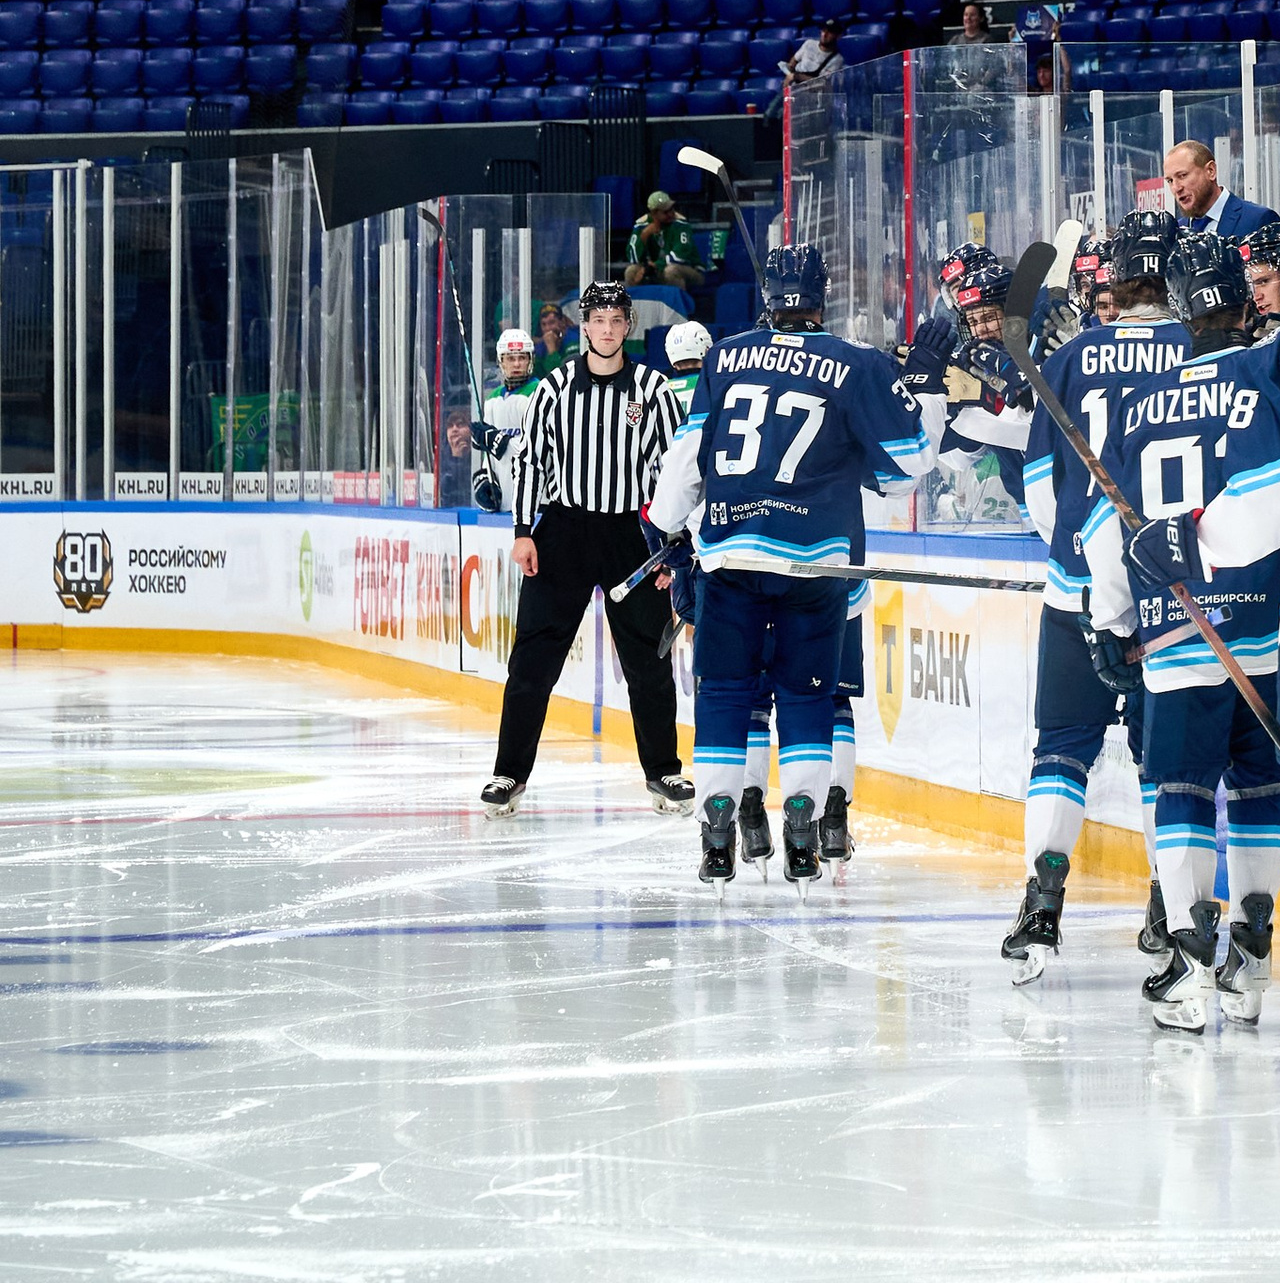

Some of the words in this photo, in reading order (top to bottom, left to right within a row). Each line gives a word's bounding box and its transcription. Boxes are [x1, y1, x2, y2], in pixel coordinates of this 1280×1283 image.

[1143, 256, 1159, 273] 14
[784, 293, 800, 308] 37
[1203, 286, 1223, 308] 91
[716, 347, 850, 390] MANGUSTOV
[1082, 343, 1184, 376] GRUNIN
[1227, 389, 1260, 430] 8
[715, 383, 828, 485] 37
[0, 480, 53, 495] KHL.RU
[118, 479, 164, 494] KHL.RU
[181, 479, 221, 495] KHL.RU
[235, 478, 266, 494] KHL.RU
[730, 499, 809, 516] НОВОСИБИРСКАЯ
[732, 508, 771, 522] ОБЛАСТЬ
[64, 533, 101, 581] 80
[128, 545, 227, 569] РОССИЙСКОМУ
[70, 582, 97, 592] ЛЕТ
[128, 574, 187, 594] ХОККЕЮ
[353, 535, 410, 641] FONBET
[910, 627, 971, 708] БАНК
